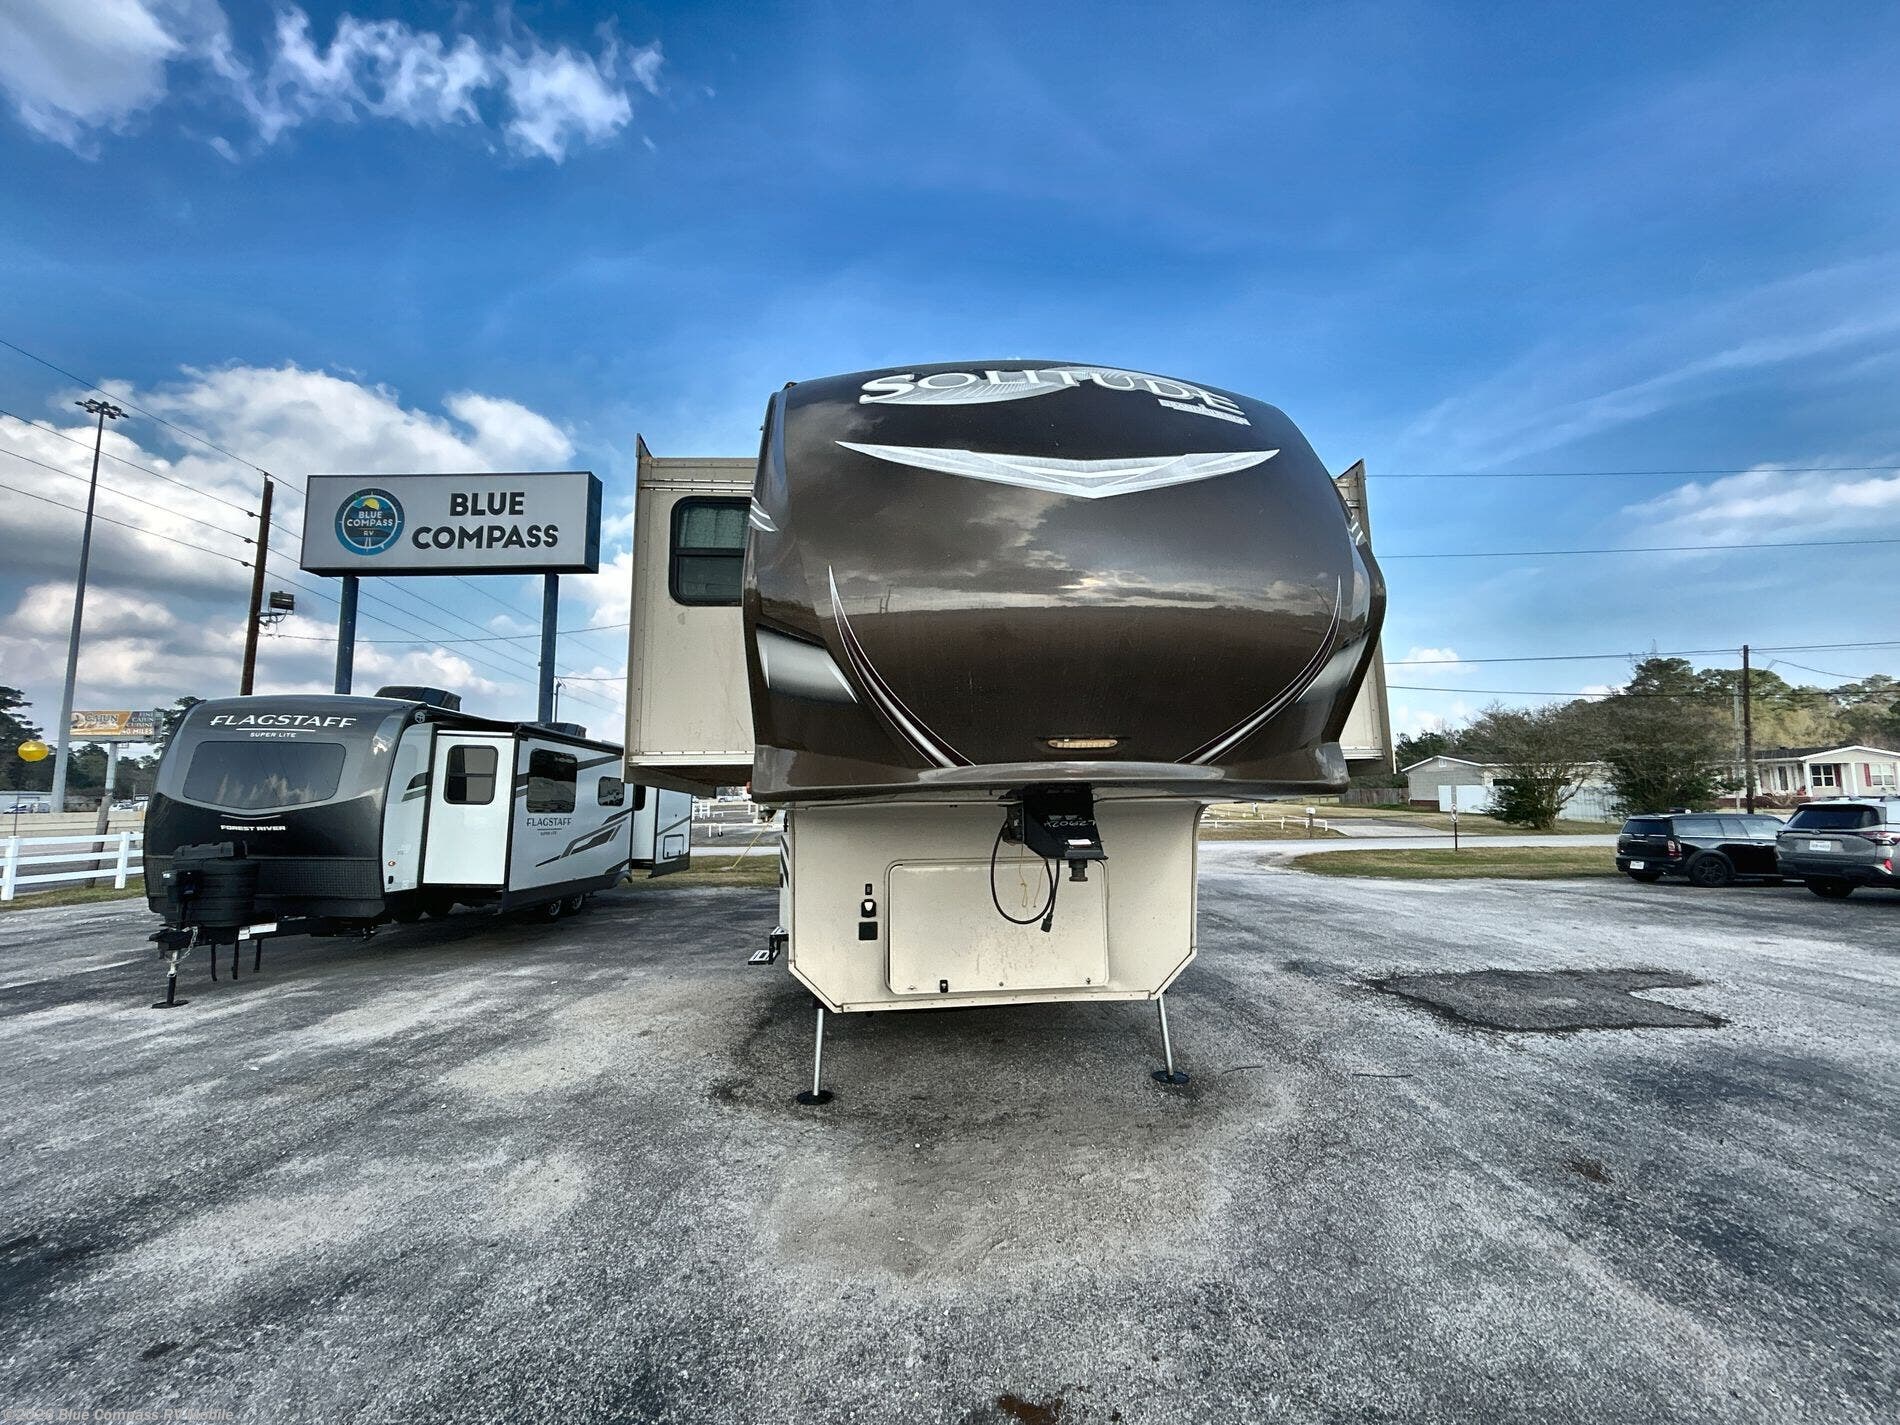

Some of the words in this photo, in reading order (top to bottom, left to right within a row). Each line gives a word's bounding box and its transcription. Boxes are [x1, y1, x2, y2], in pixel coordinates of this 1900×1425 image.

[859, 366, 1246, 416] SOLITUDE
[450, 491, 525, 516] BLUE
[358, 511, 383, 519] BLUE
[346, 519, 394, 527] COMPASS
[411, 524, 559, 550] COMPASS
[210, 714, 357, 728] FLAGSTAFF
[526, 817, 572, 827] FLAGSTAFF
